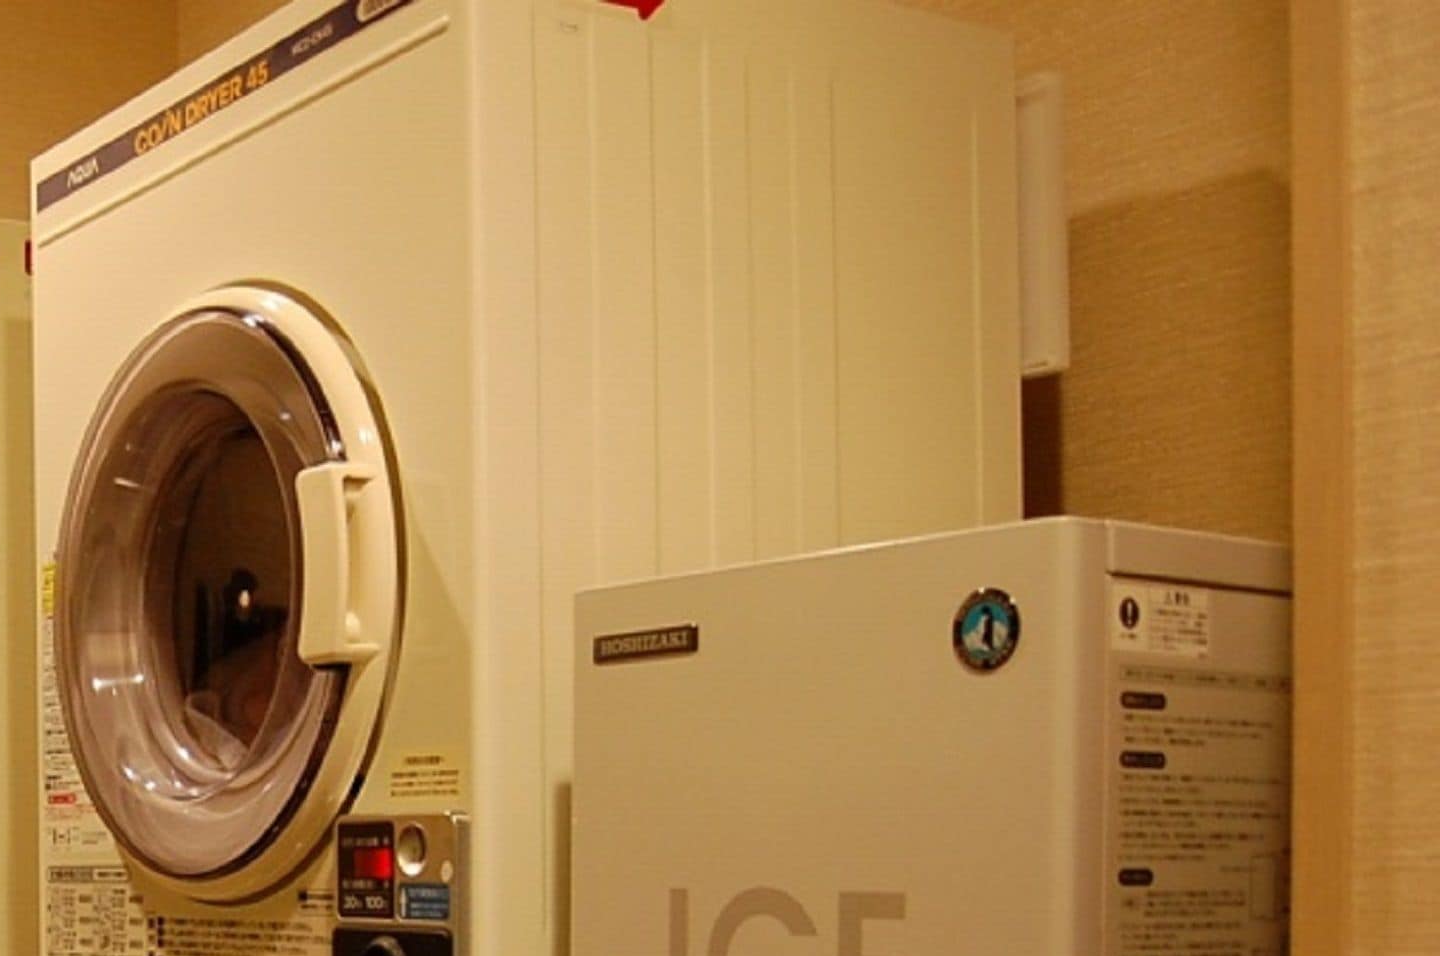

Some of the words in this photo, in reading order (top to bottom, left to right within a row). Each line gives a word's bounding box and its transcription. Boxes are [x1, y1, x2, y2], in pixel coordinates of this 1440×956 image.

[185, 75, 242, 127] DRYER
[246, 60, 269, 88] 45
[600, 631, 688, 657] HOSHIZAKI
